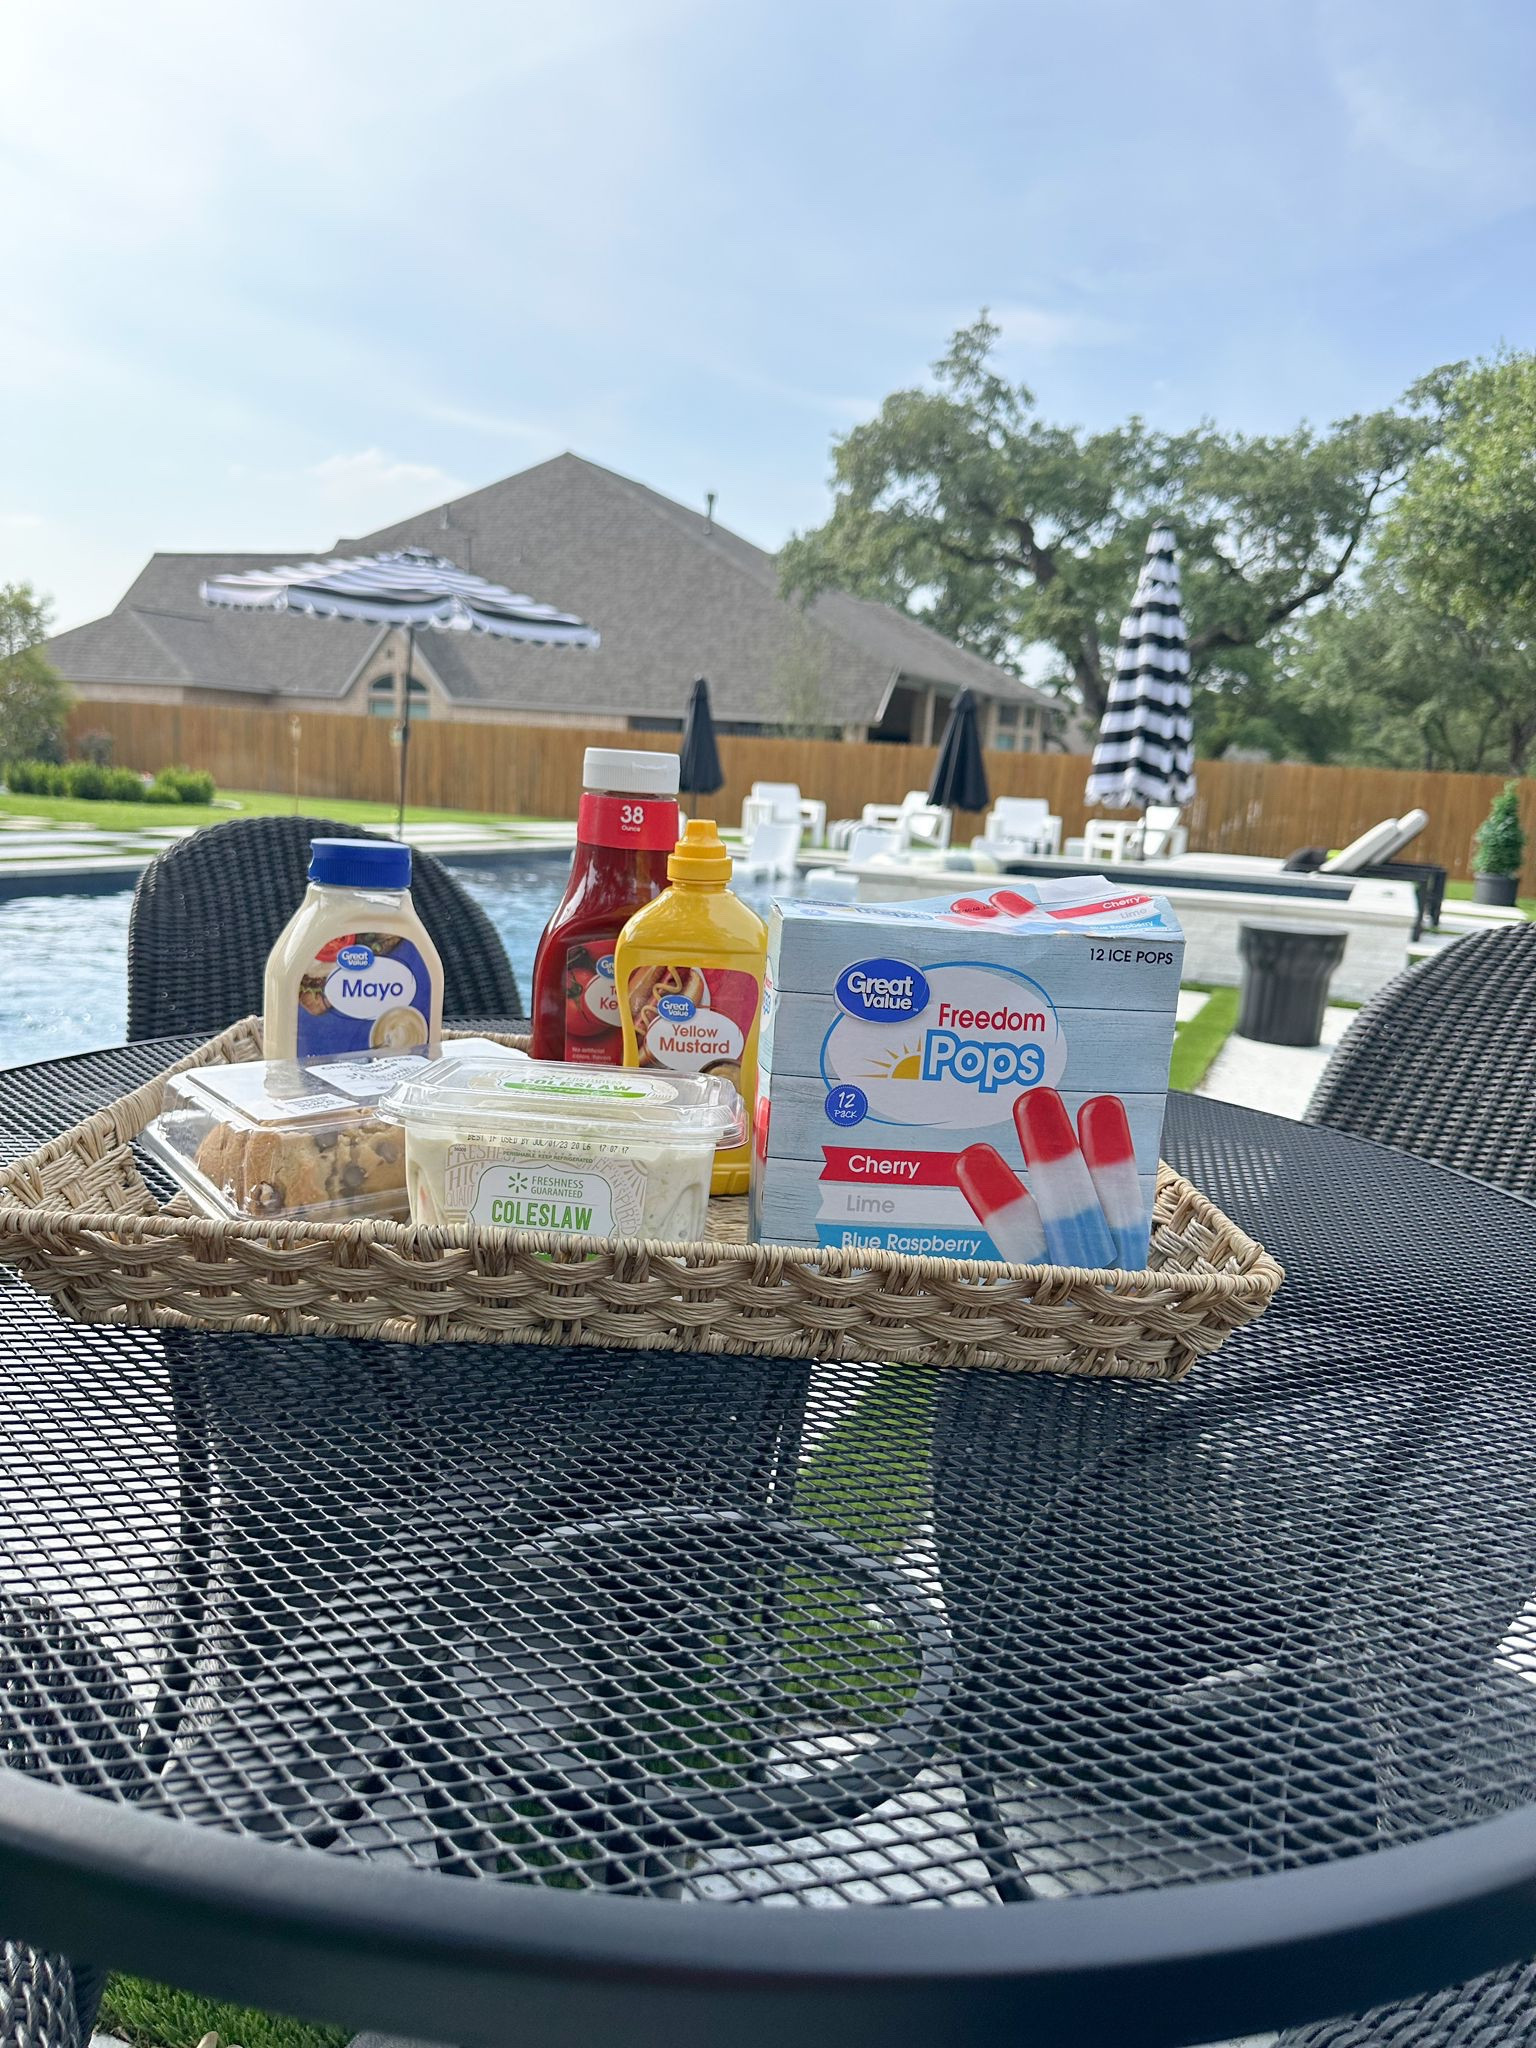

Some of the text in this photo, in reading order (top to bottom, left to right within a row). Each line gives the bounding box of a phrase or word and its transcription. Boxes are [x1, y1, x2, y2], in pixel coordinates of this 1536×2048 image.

[620, 805, 644, 825] 38
[1102, 896, 1141, 909] Cherry
[341, 951, 369, 961] Great
[1090, 948, 1174, 965] 12 ICE POPS
[342, 979, 404, 1001] Mayo
[847, 971, 914, 997] Great
[662, 1000, 689, 1011] Great
[862, 993, 913, 1010] Value
[668, 1008, 689, 1017] Value
[938, 1003, 1046, 1032] Freedom
[672, 1024, 719, 1038] Yellow
[659, 1036, 730, 1054] Mustard
[922, 1029, 1045, 1093] Pops
[521, 1078, 633, 1091] COLESLAW
[838, 1091, 856, 1108] 12
[848, 1154, 921, 1179] Cherry
[531, 1175, 584, 1189] FRESHNESS
[530, 1186, 583, 1199] GUARANTEED
[846, 1194, 896, 1214] Lime
[491, 1199, 593, 1231] COLESLAW
[841, 1231, 982, 1256] Blue Raspberry
